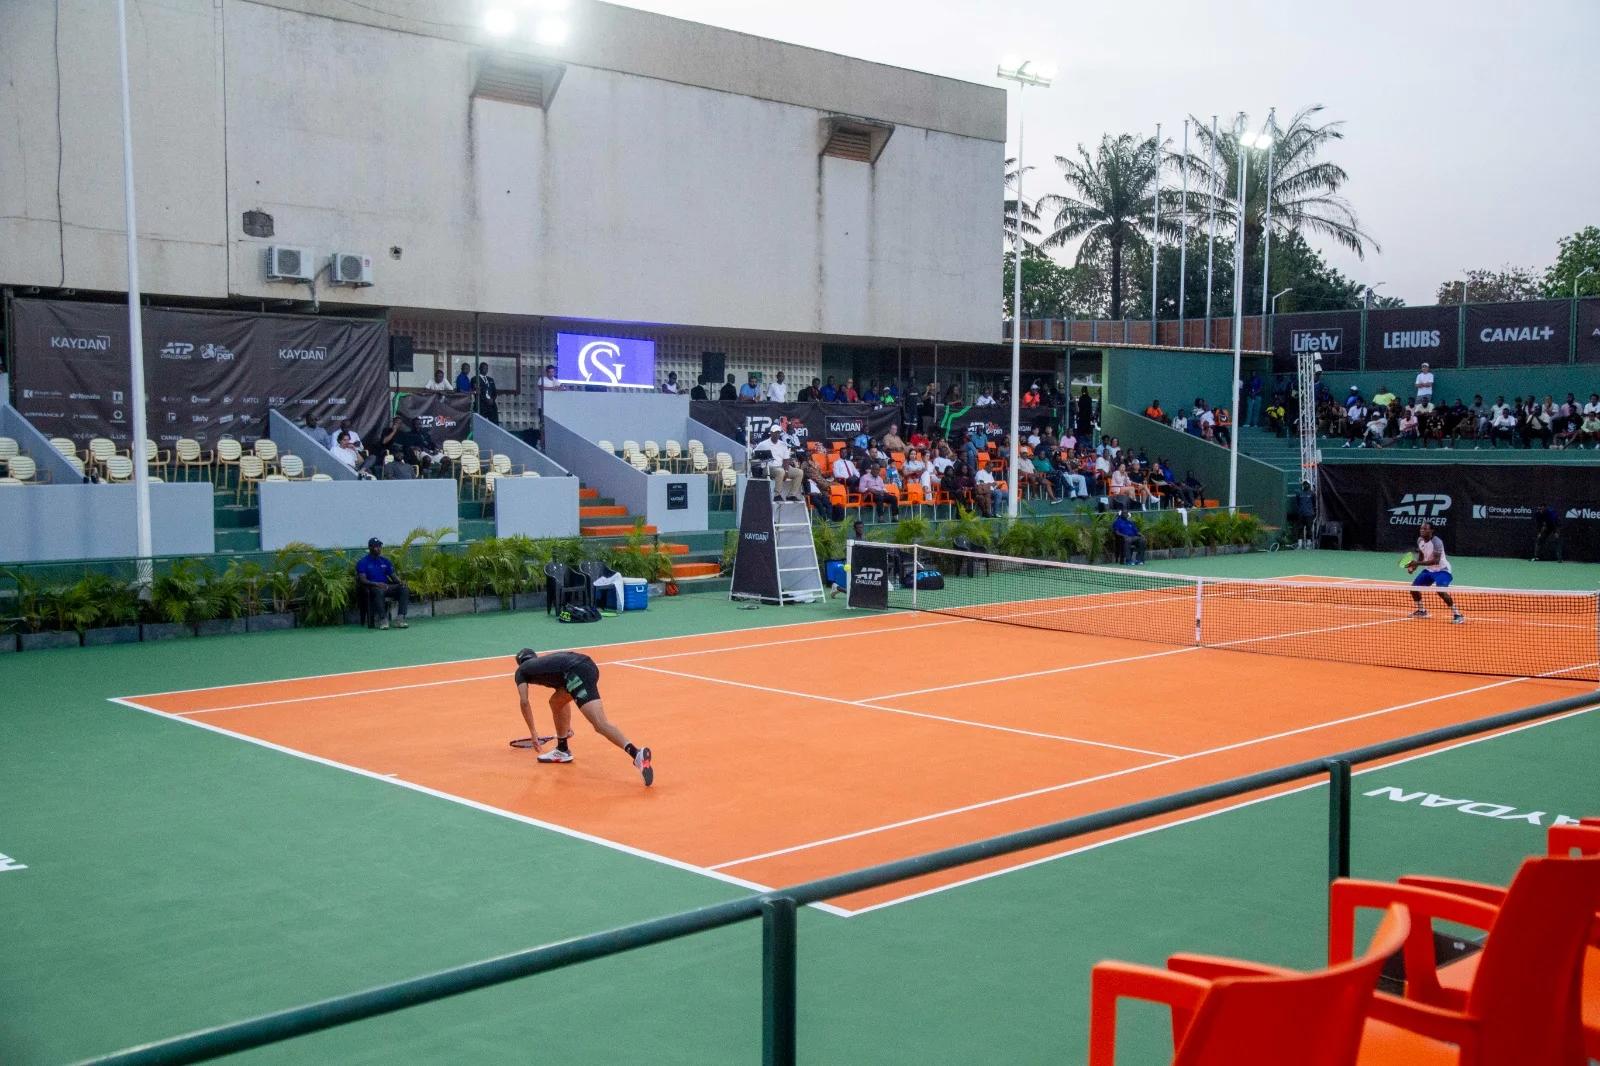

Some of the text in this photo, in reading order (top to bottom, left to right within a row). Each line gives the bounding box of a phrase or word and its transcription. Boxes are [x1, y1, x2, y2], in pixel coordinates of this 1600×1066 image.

[1383, 330, 1441, 349] LEHUBS
[1480, 325, 1554, 343] CANAL+
[51, 336, 107, 350] KAYDAN
[1293, 332, 1339, 351] Lifetv
[160, 342, 195, 354] ATP
[279, 349, 324, 360] KAYDAN
[830, 422, 861, 432] KAYDAN
[1387, 494, 1452, 516] ATP
[1488, 506, 1532, 515] Groupe cofina
[1390, 516, 1447, 526] CHALLENGER
[744, 532, 767, 541] KAYDAN
[854, 567, 884, 580] ATP
